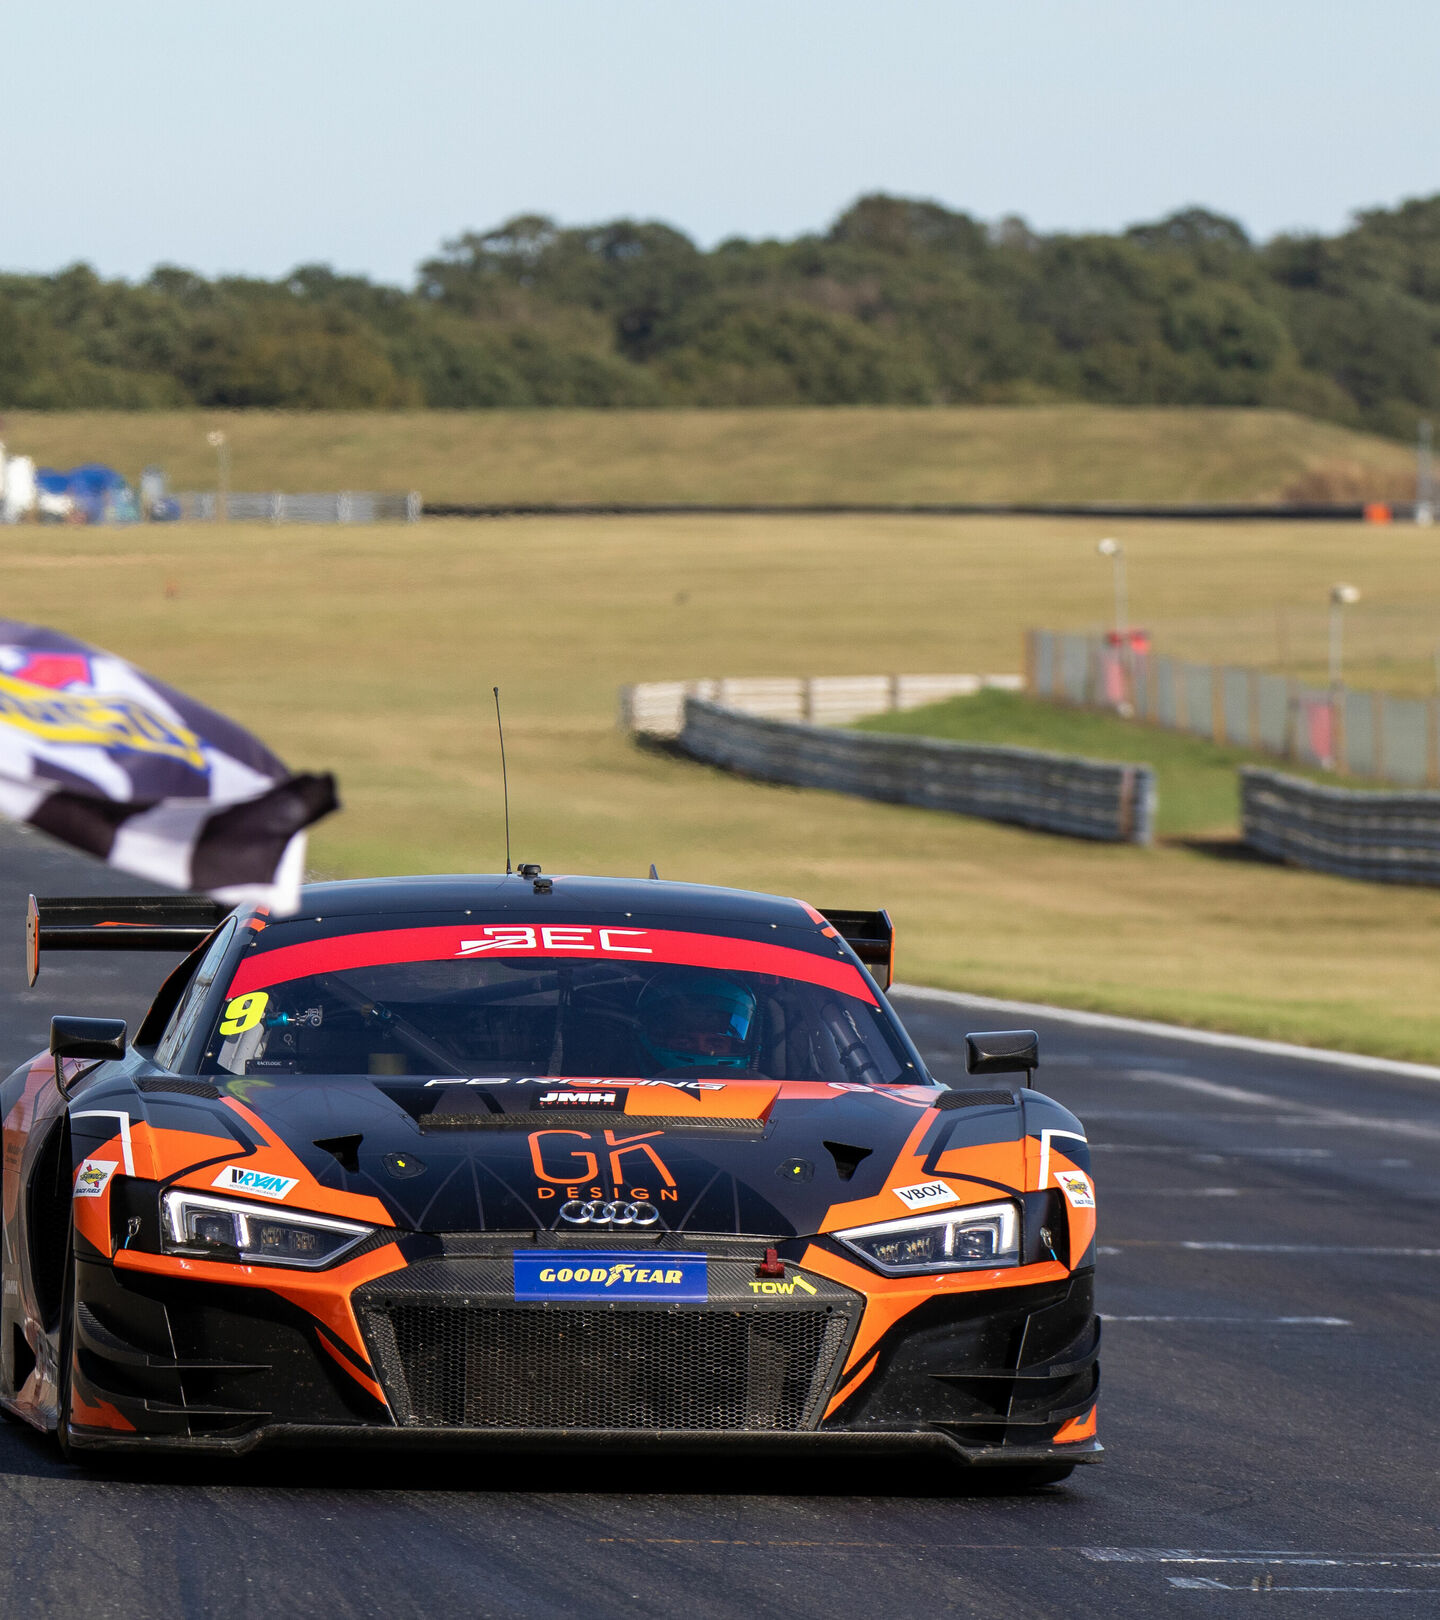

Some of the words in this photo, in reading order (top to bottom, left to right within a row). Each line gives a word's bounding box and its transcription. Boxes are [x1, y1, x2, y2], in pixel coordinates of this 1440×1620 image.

[454, 927, 653, 956] BEC
[219, 991, 269, 1036] 9
[515, 1077, 727, 1091] RACING
[539, 1092, 617, 1103] JMH
[527, 1129, 677, 1187] GK
[238, 1172, 290, 1192] RYAN
[537, 1187, 678, 1201] DESIGN
[899, 1183, 948, 1201] VBOX
[539, 1263, 684, 1287] GOODYEAR
[748, 1282, 796, 1296] TOW
